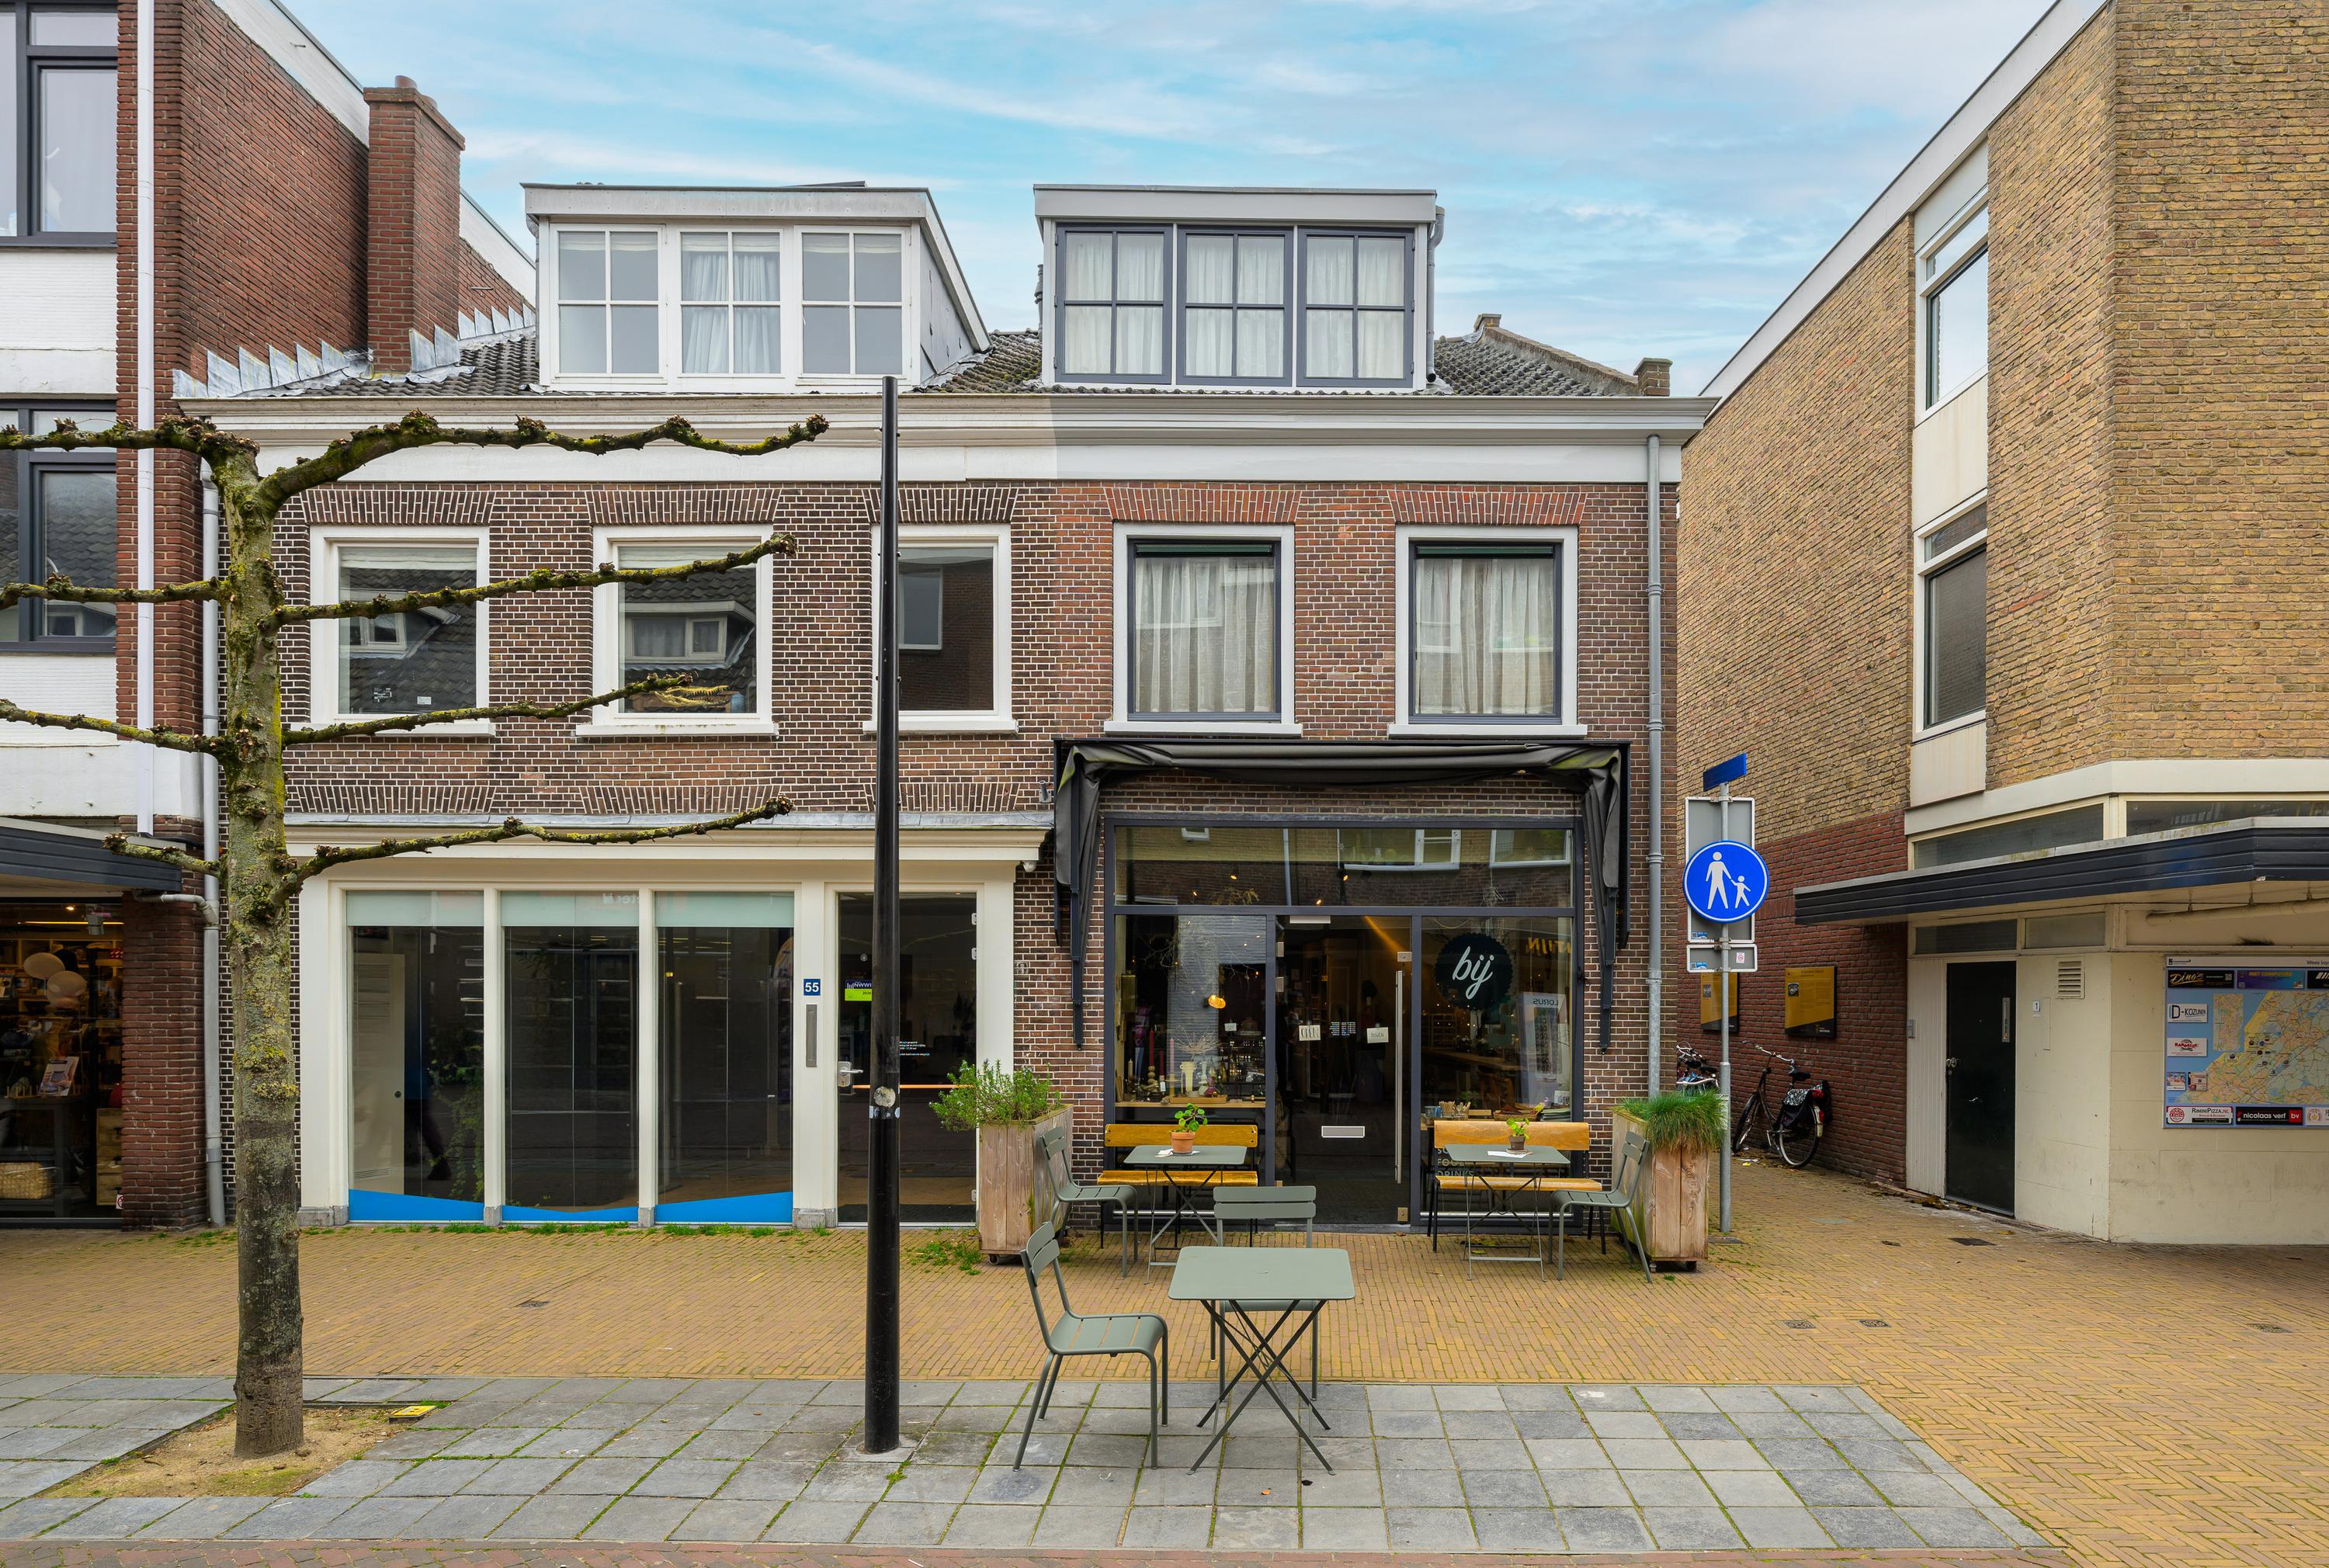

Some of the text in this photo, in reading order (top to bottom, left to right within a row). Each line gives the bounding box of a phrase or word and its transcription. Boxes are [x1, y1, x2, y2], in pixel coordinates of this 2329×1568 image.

[1452, 945, 1494, 1000] bij
[804, 982, 819, 992] 55
[1300, 1028, 1319, 1039] OPEN
